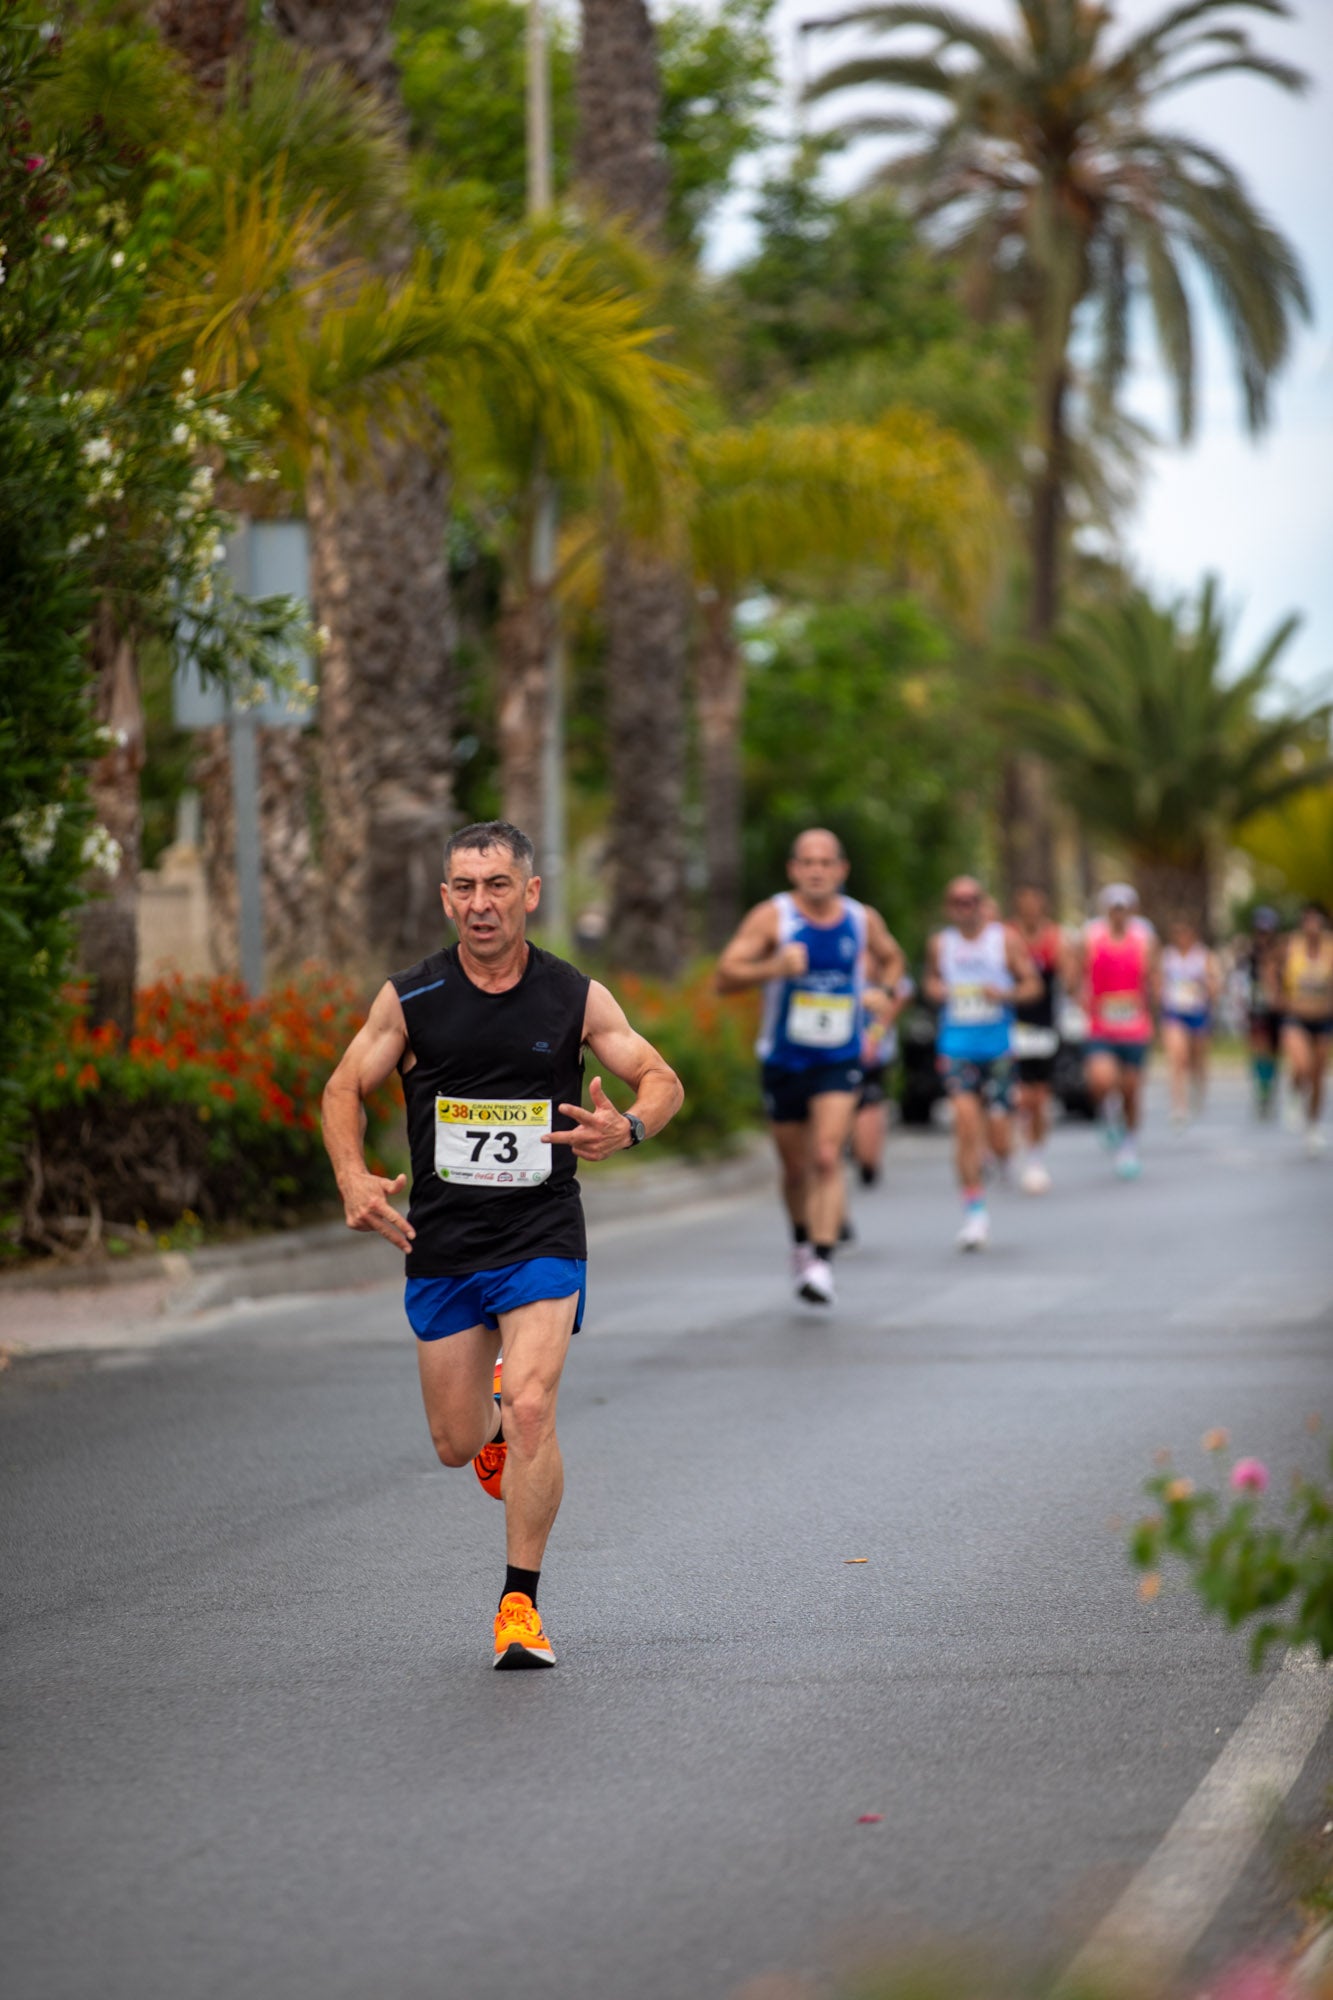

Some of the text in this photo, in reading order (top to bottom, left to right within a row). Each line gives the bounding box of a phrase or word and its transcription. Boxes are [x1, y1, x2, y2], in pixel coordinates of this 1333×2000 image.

[452, 1104, 527, 1120] 38 FONDO
[466, 1131, 518, 1163] 73
